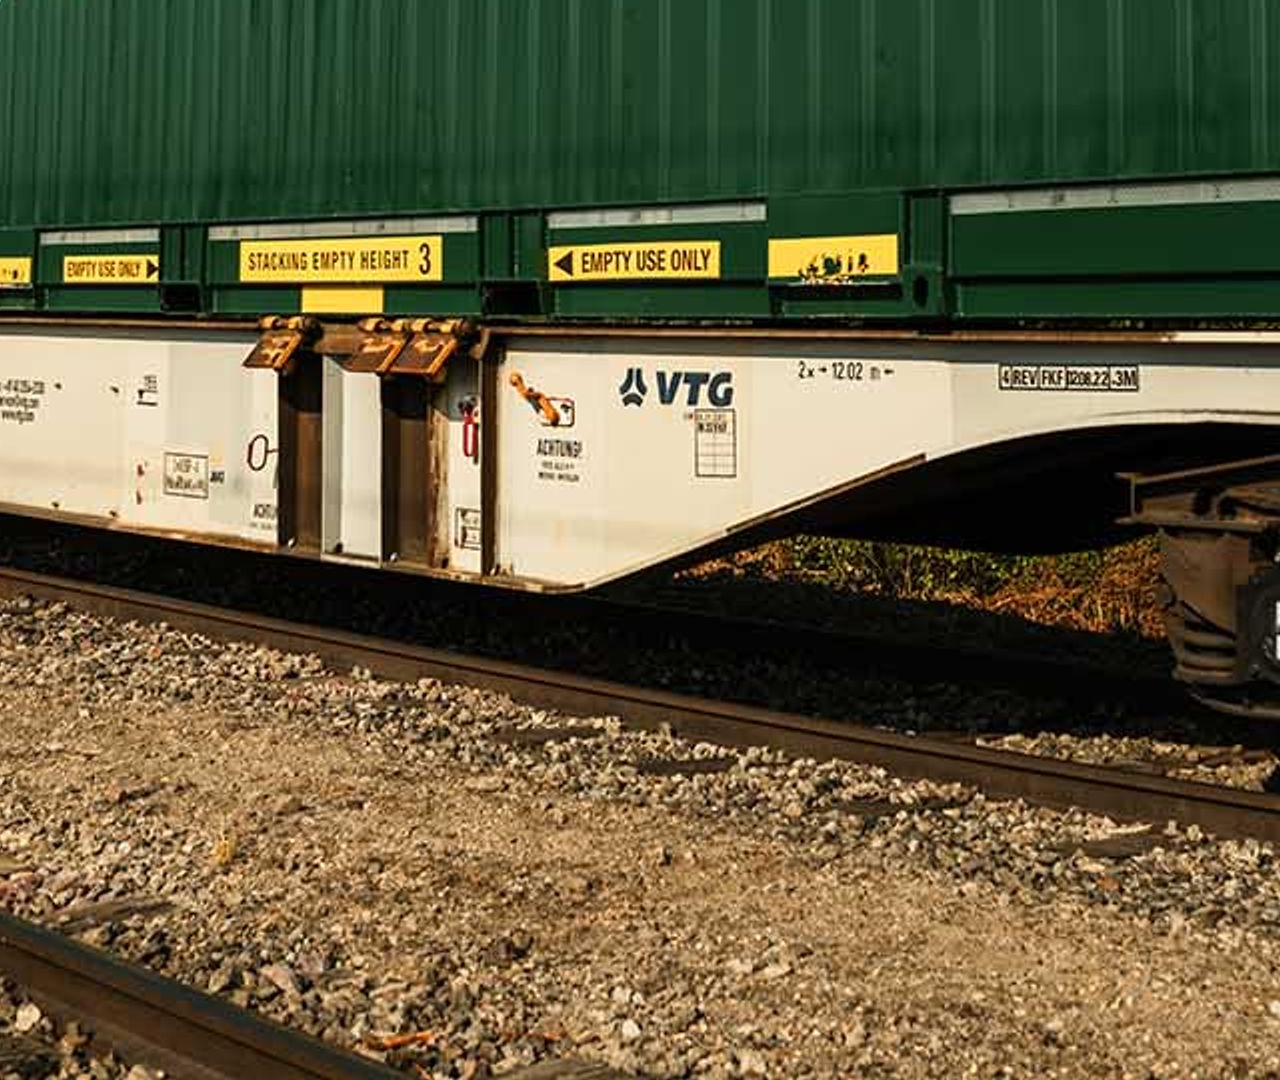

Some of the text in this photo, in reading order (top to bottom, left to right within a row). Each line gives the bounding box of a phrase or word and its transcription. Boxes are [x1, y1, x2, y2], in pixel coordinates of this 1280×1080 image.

[67, 262, 96, 278] EMPTY
[248, 243, 432, 275] STACKING EMPTY HEIGHT 3
[582, 248, 711, 273] EMPTY USE ONLY
[656, 370, 734, 407] VTG
